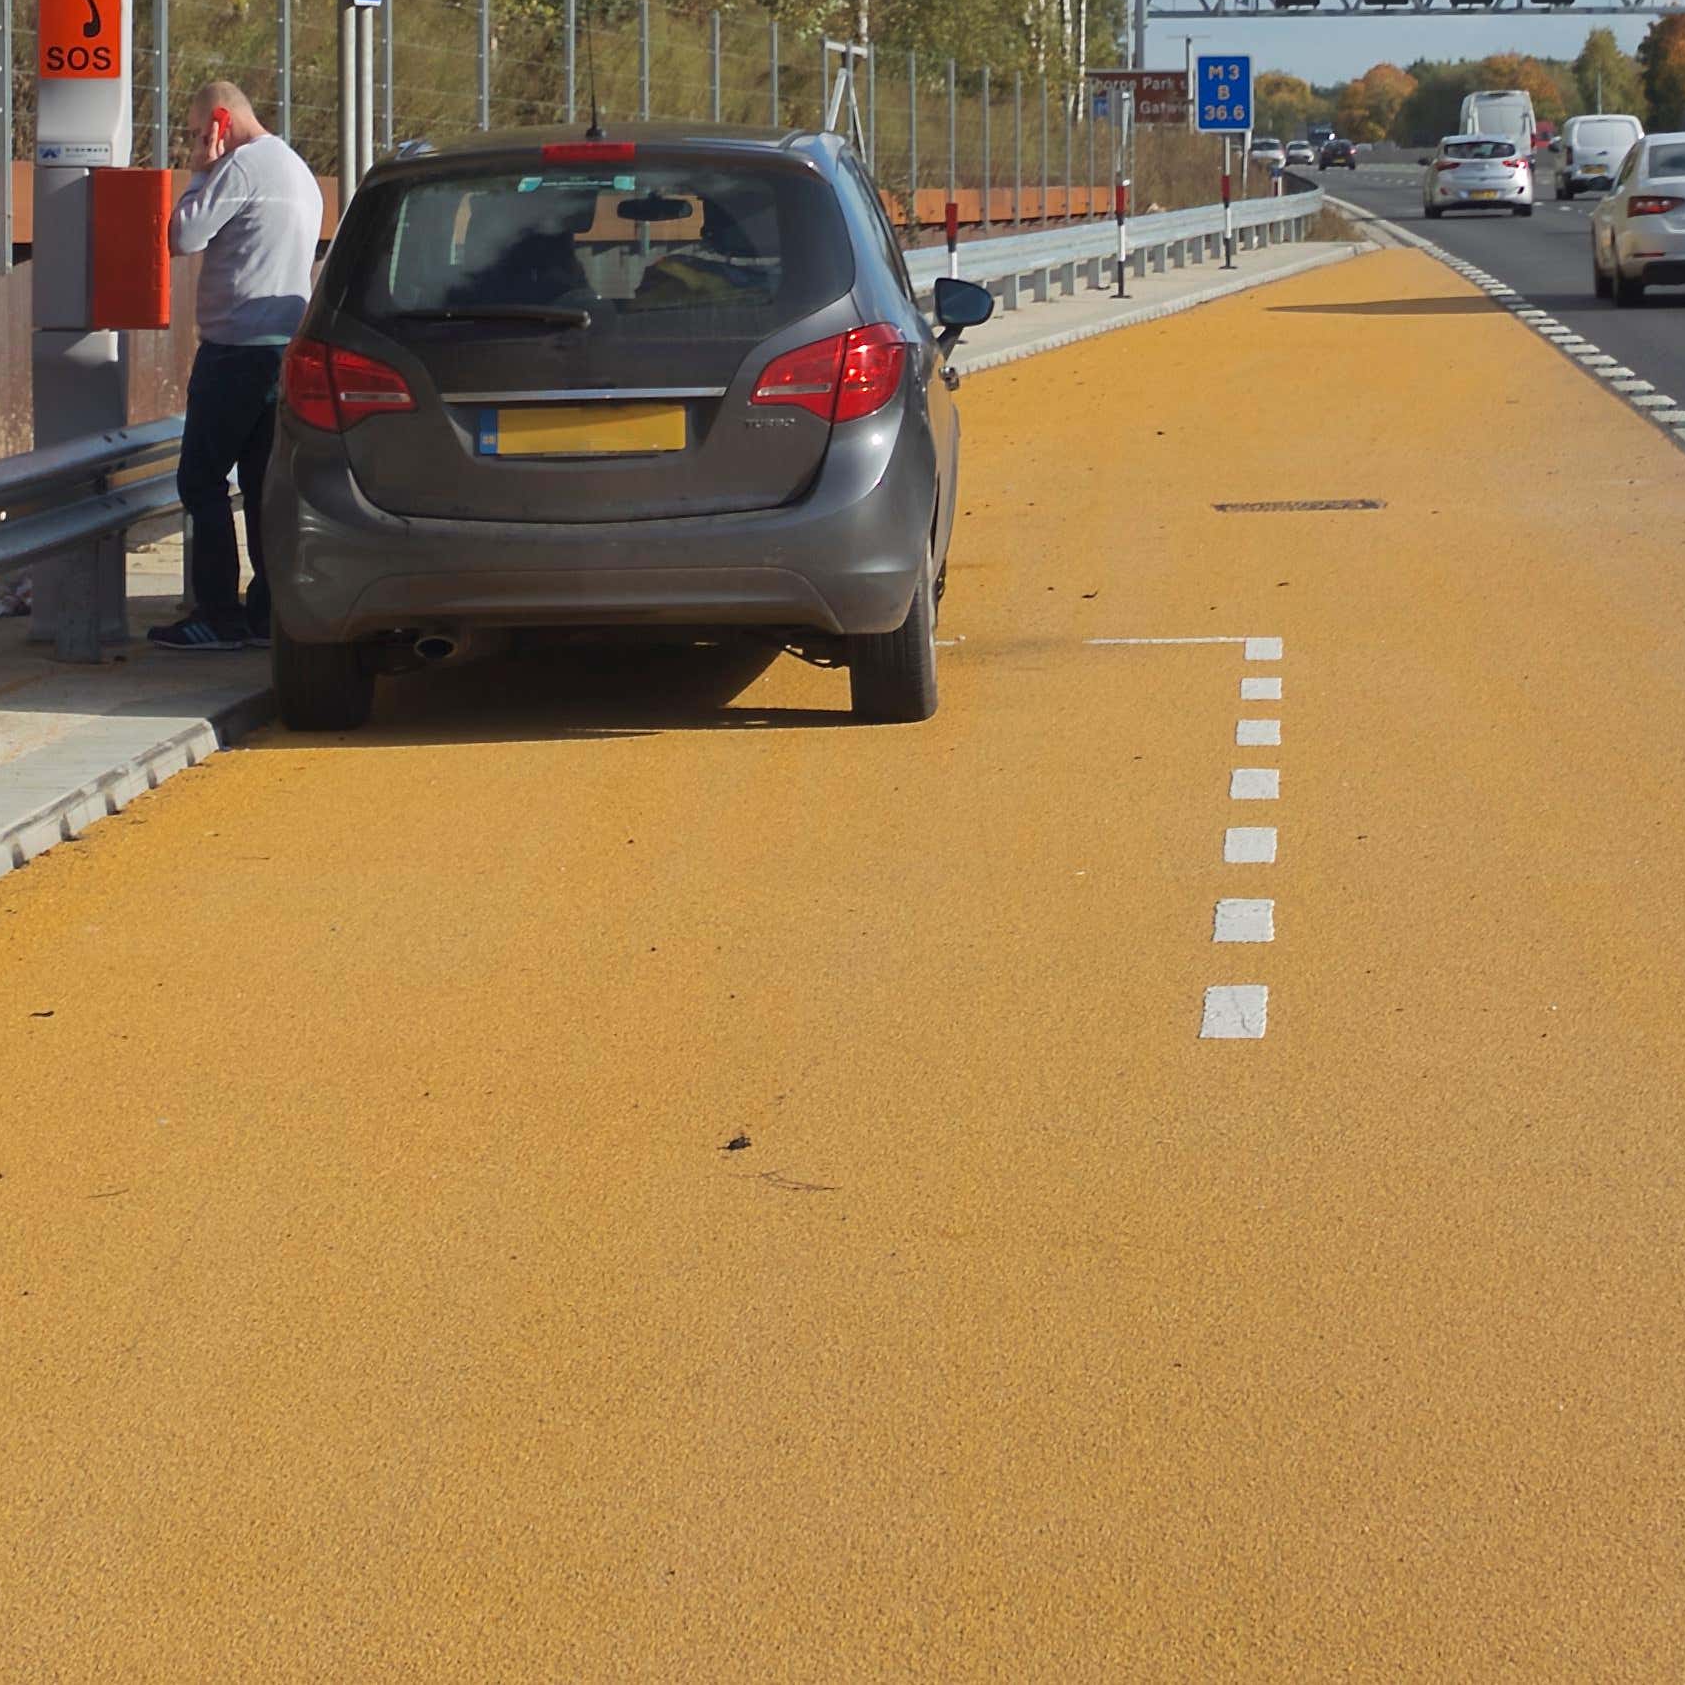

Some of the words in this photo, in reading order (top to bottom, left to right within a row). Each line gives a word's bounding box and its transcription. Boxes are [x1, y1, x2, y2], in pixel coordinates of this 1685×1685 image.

[46, 46, 111, 71] SOS
[1142, 76, 1175, 91] Park
[1217, 85, 1230, 101] B
[1204, 105, 1245, 122] 36.6
